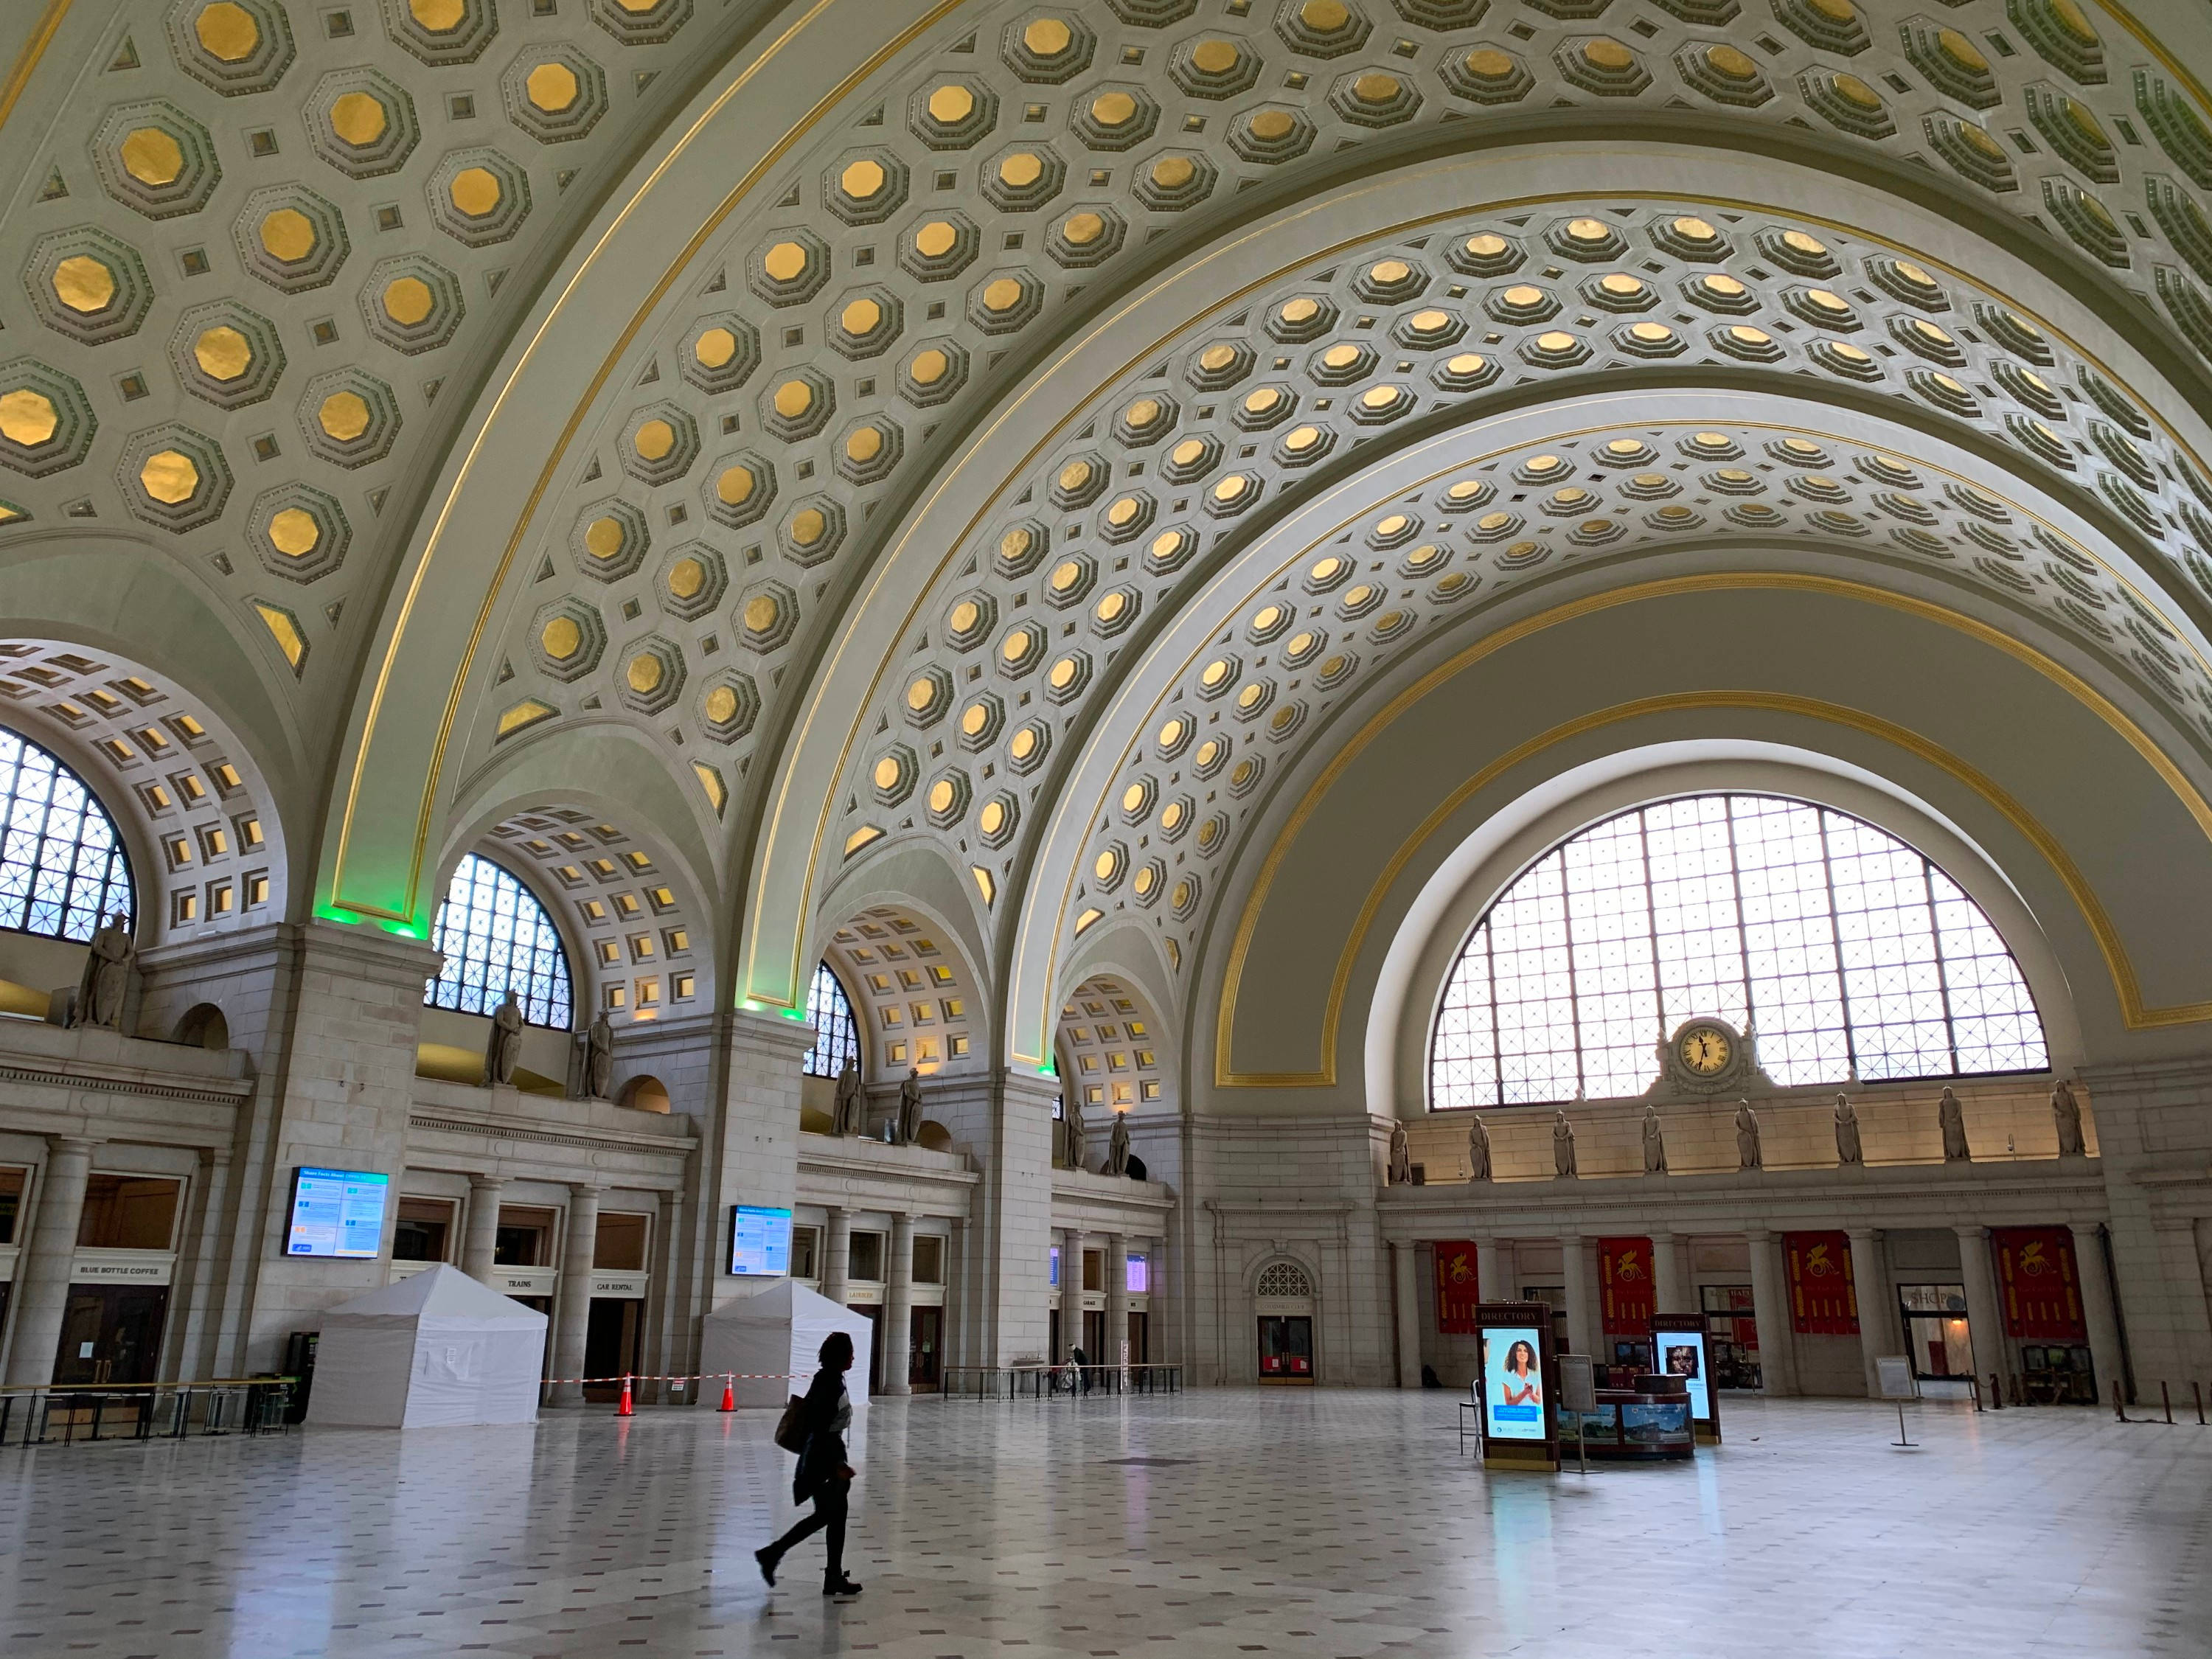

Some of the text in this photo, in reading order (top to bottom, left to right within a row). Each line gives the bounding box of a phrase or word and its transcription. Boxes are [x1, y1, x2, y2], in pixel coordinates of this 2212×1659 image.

[101, 1267, 129, 1275] BOTTLE
[1481, 1312, 1537, 1321] DIRECTORY
[1655, 1320, 1700, 1328] DIRECTORY
